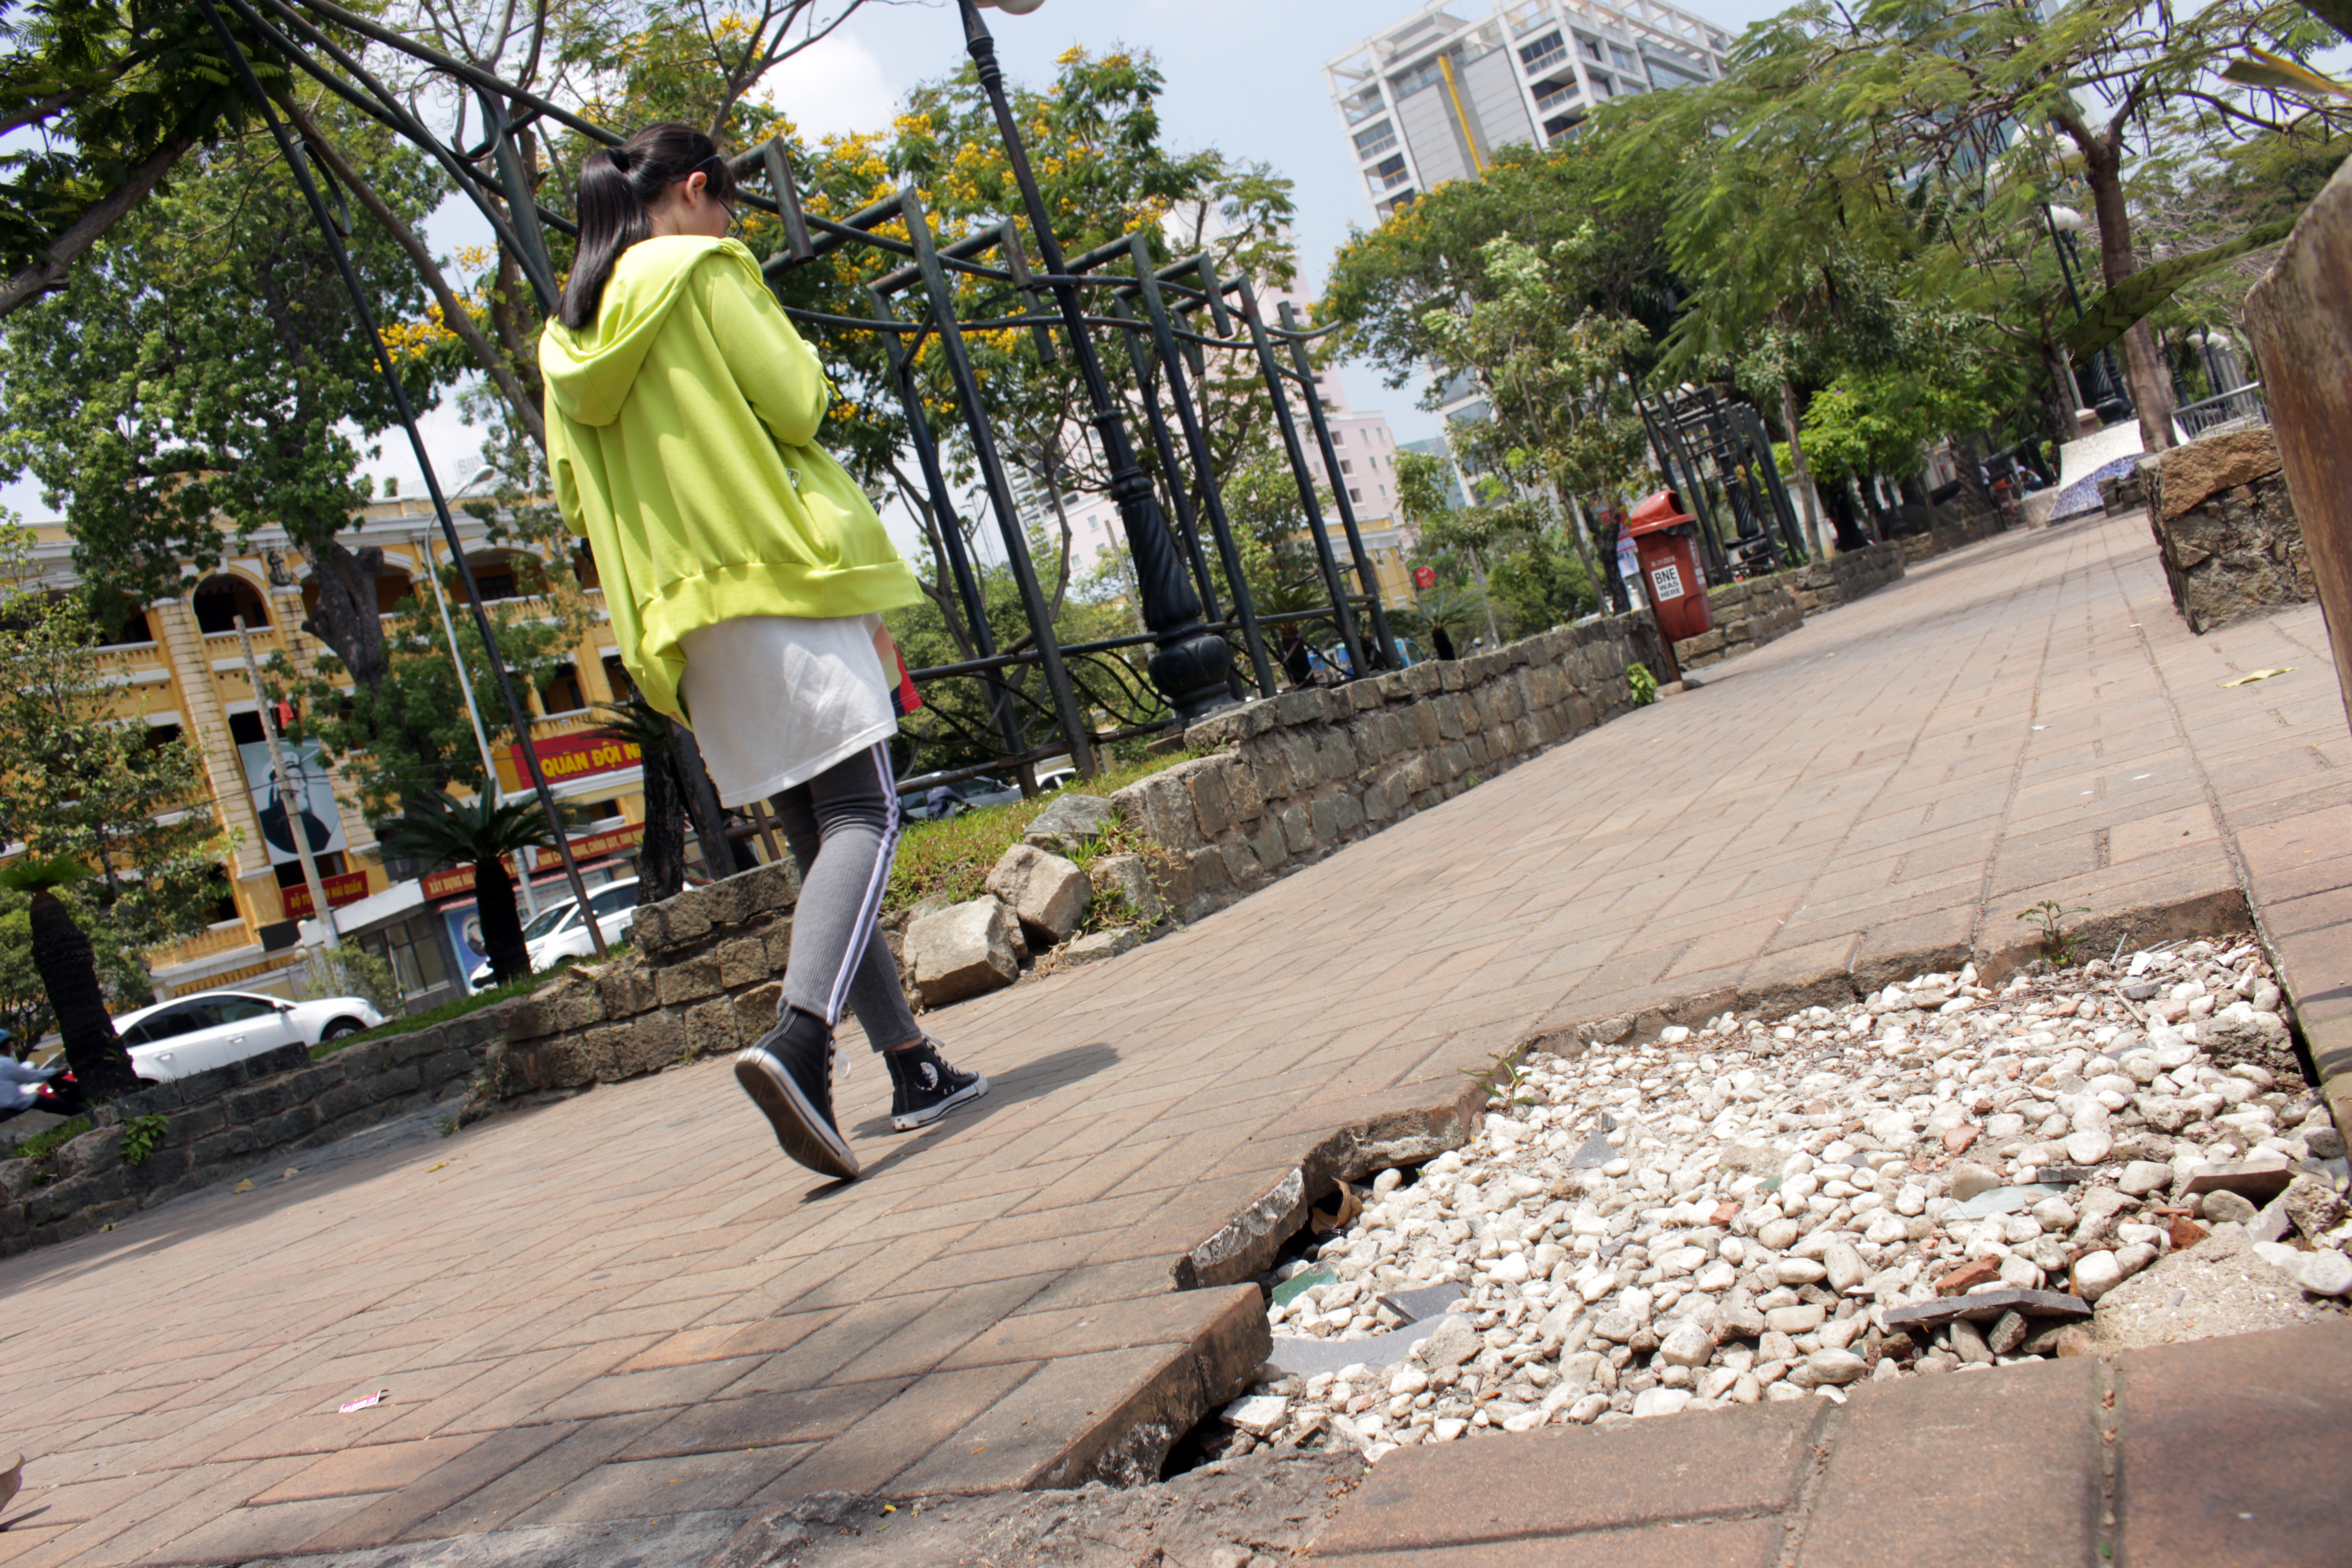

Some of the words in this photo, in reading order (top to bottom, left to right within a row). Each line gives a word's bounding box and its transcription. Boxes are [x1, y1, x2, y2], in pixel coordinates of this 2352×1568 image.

[1655, 568, 1677, 584] BNE
[1658, 580, 1679, 591] WAS
[1660, 587, 1681, 598] HERE
[541, 751, 589, 777] QUÂN
[591, 741, 622, 768] ĐỘI
